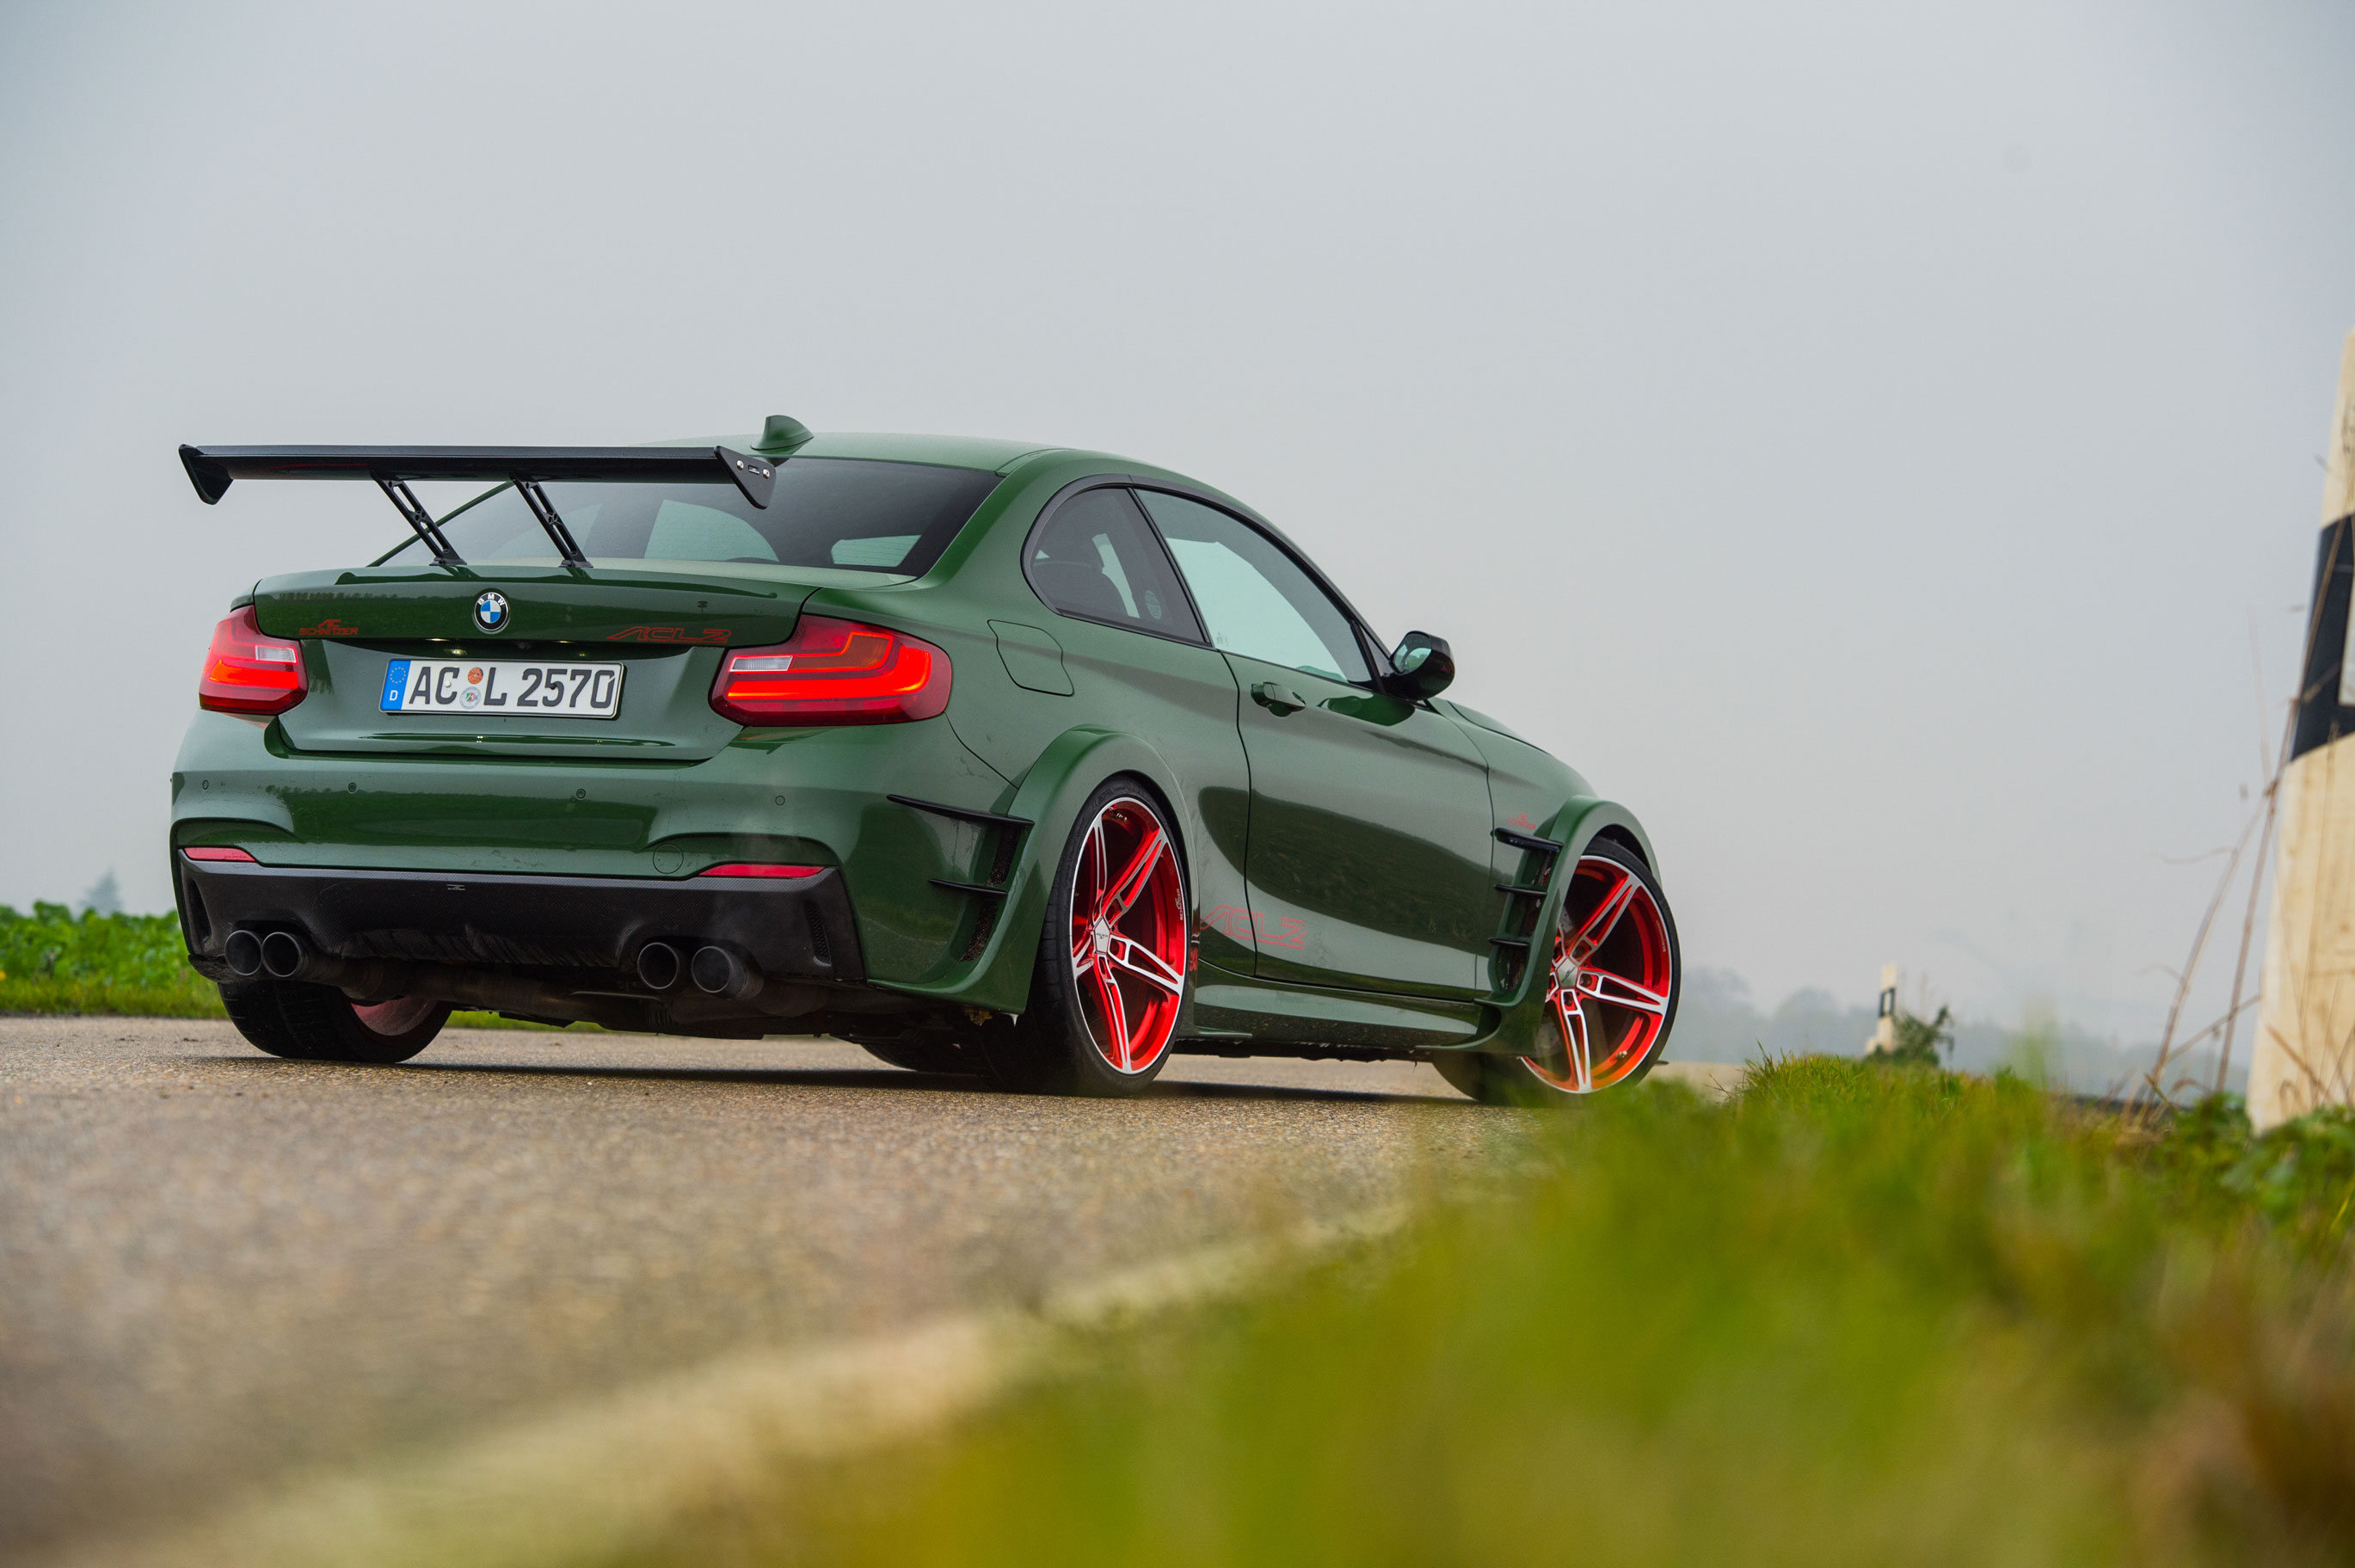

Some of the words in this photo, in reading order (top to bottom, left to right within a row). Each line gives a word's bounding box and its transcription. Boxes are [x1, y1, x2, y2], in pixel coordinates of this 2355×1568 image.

[477, 593, 506, 606] BMW
[298, 627, 359, 636] SCHNITZER
[606, 626, 732, 643] ACL2
[409, 666, 460, 705] AC
[483, 667, 507, 706] L
[516, 668, 616, 709] 2570
[389, 690, 398, 701] D
[1200, 904, 1307, 950] ACL2
